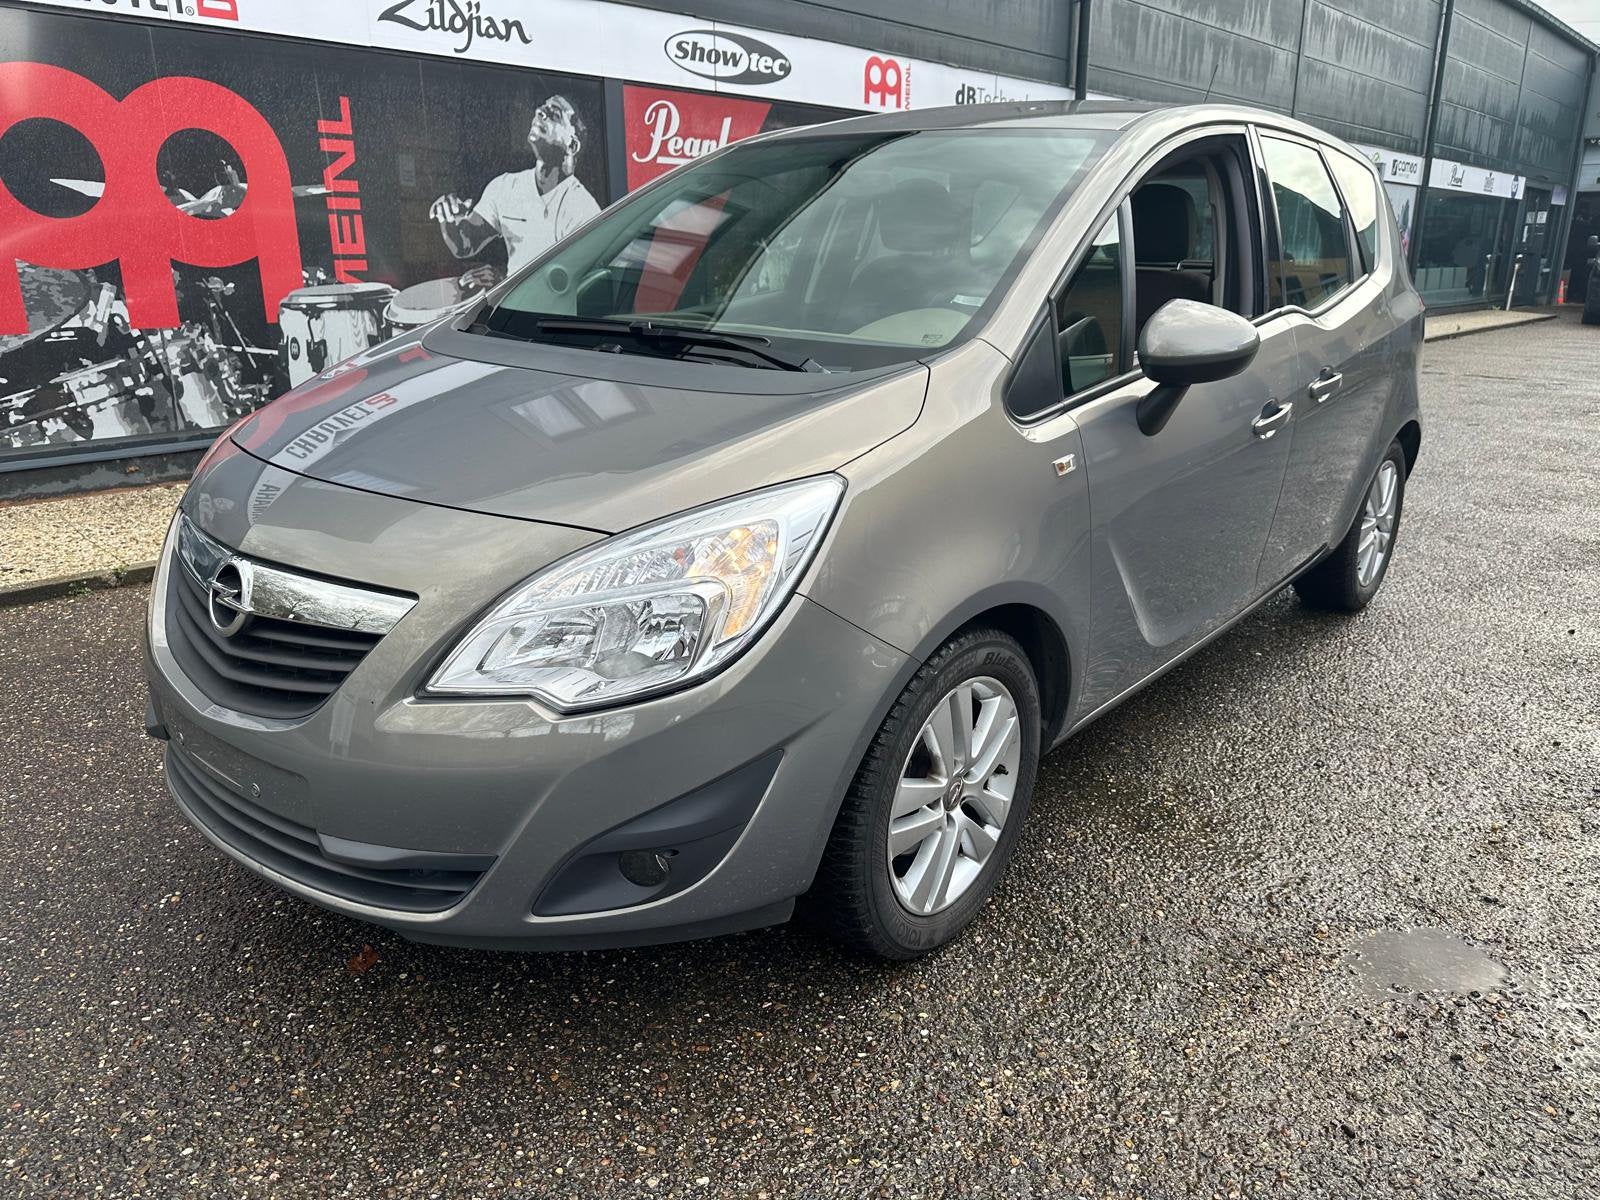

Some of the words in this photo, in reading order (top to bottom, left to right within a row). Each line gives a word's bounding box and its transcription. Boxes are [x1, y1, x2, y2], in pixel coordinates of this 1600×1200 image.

[377, 0, 533, 53] Zildjian
[675, 40, 786, 75] Showtec
[632, 100, 732, 162] Pearl
